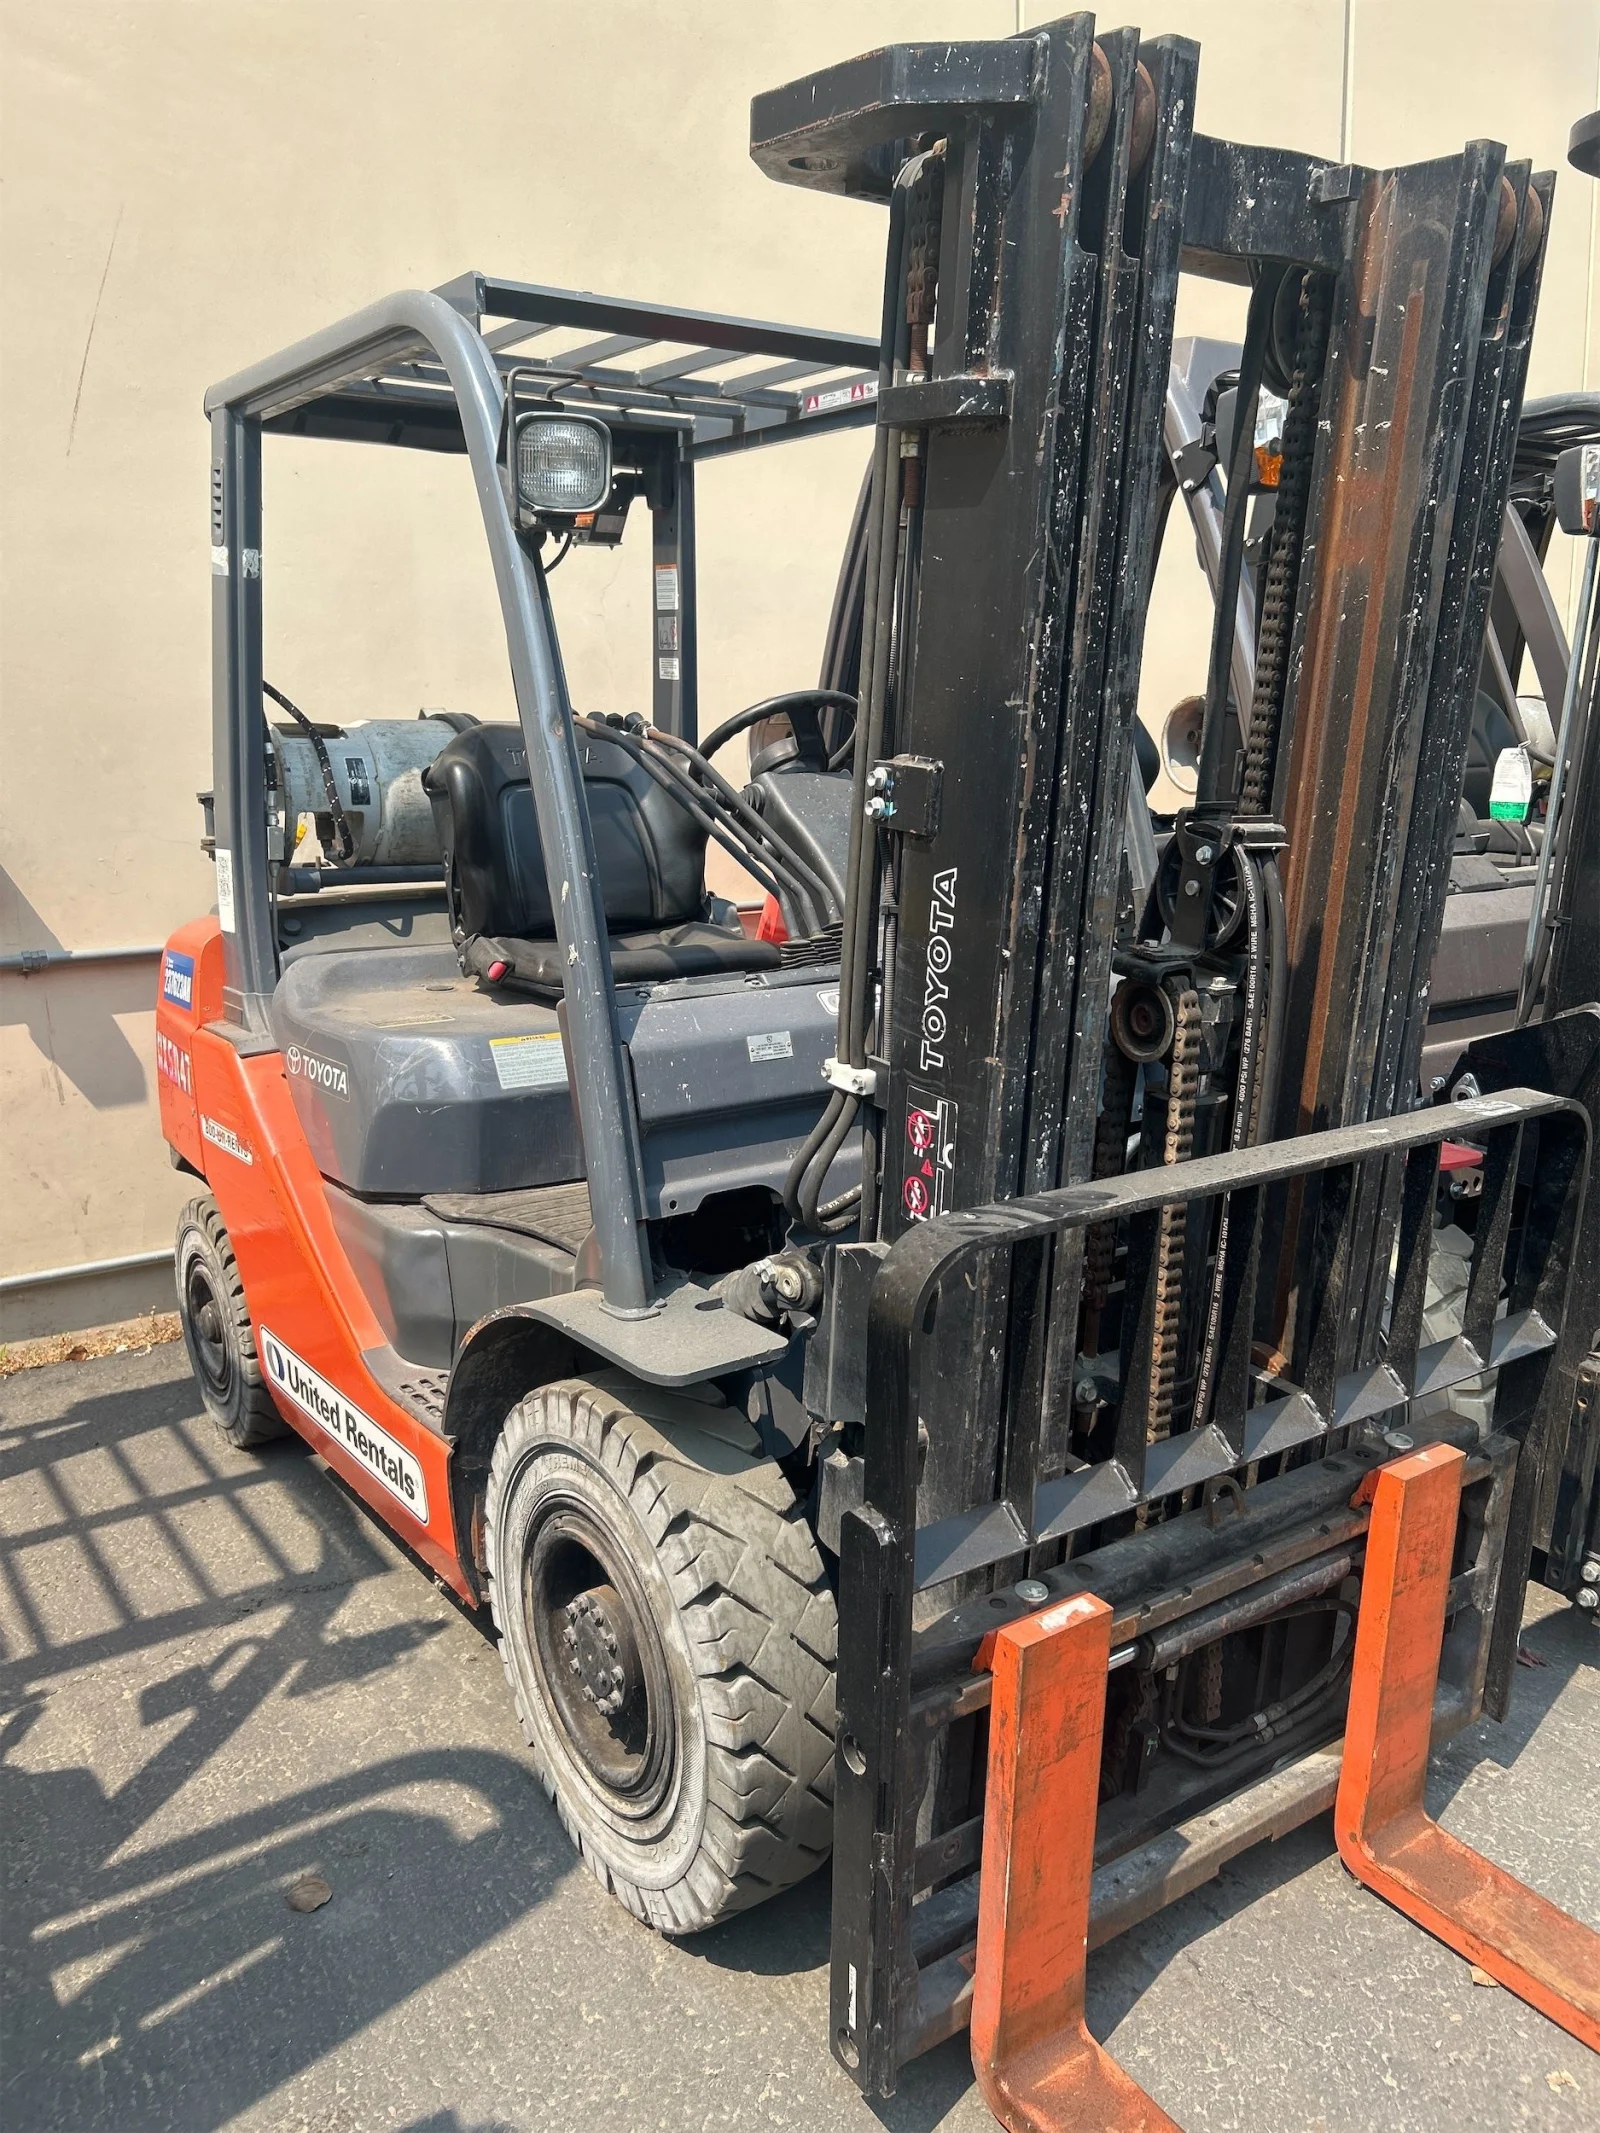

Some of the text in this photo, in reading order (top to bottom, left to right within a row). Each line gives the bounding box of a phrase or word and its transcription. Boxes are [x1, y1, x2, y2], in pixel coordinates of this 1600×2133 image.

[1249, 902, 1258, 927] MSHA
[1250, 931, 1258, 953] WIRE
[920, 867, 958, 1071] TOYOTA
[1247, 965, 1257, 1009] SAE100R16
[302, 1055, 348, 1094] TOYOTA
[1242, 1057, 1249, 1070] WP
[1240, 1071, 1248, 1084] PSI
[1238, 1084, 1246, 1102] 4000
[1217, 1250, 1226, 1271] MSHA
[287, 1360, 415, 1500] United Rentals
